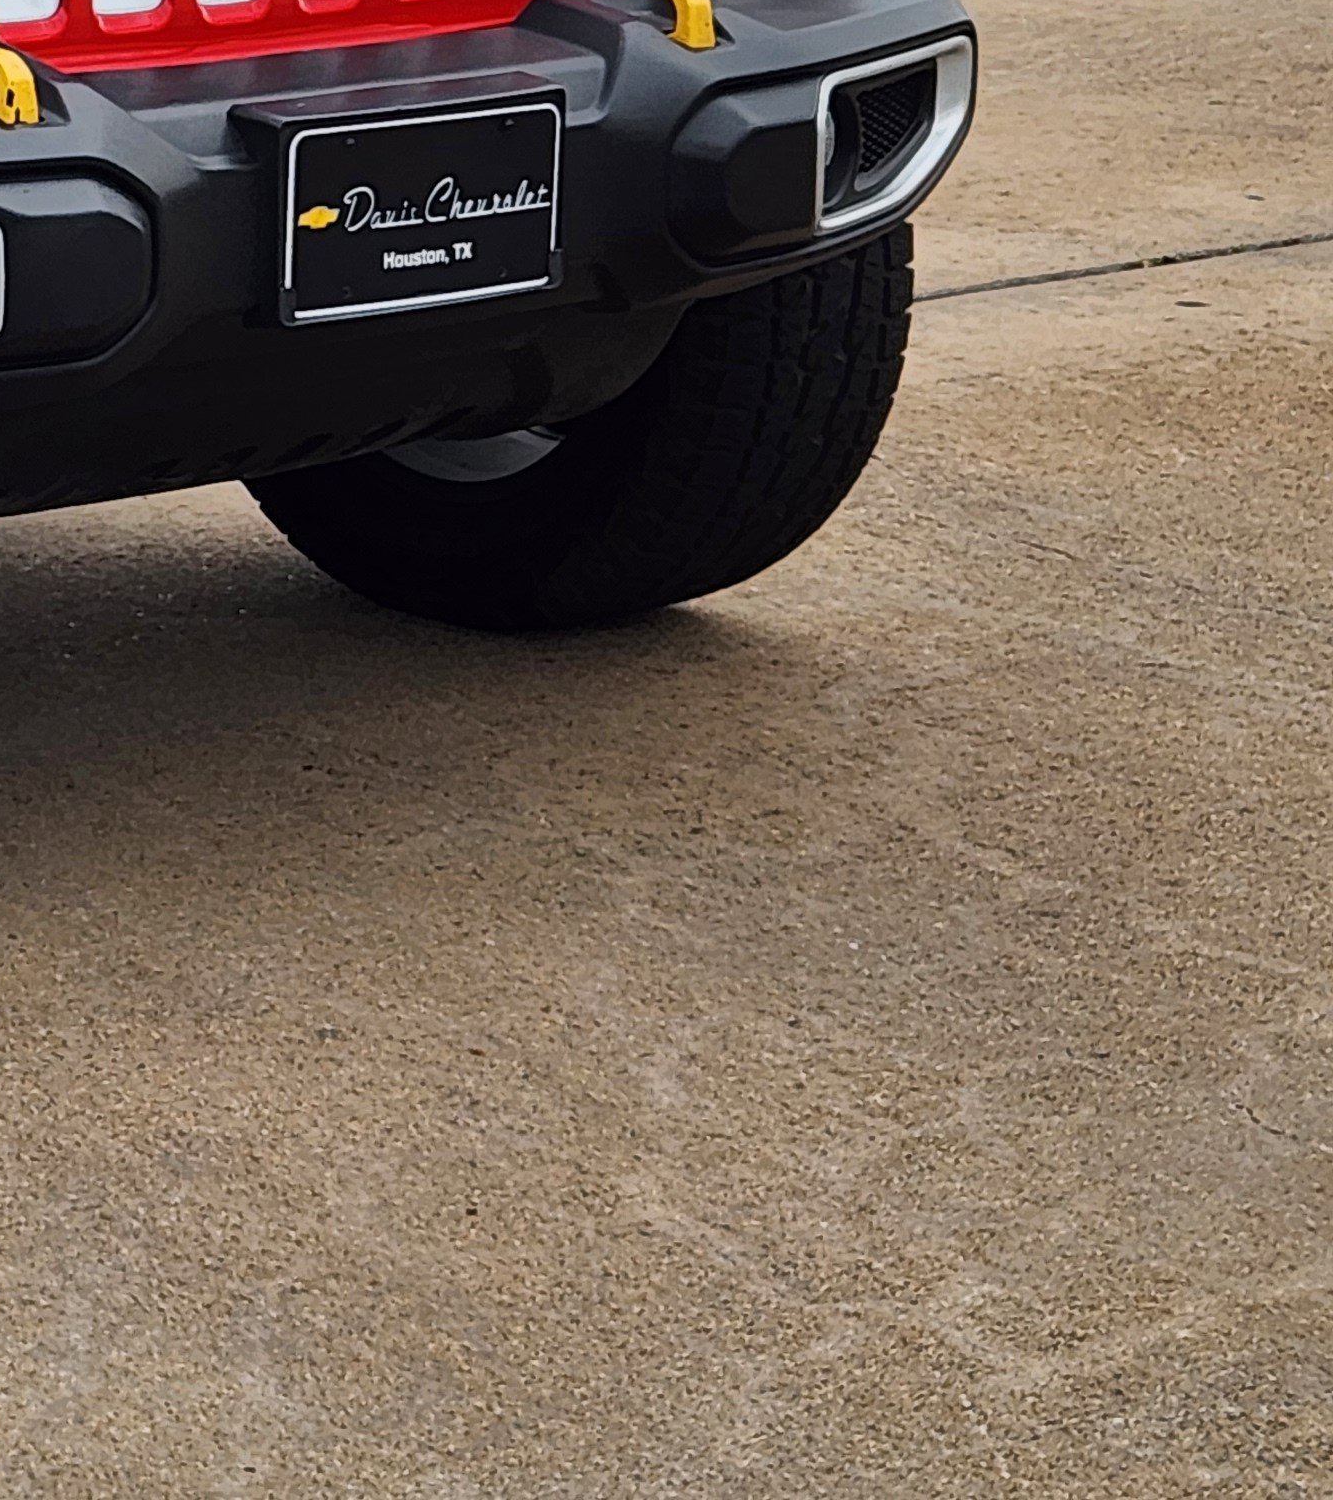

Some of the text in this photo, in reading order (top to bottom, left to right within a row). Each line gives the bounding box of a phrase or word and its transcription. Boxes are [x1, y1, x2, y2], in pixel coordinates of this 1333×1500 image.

[343, 176, 551, 232] Davis Chevrolet
[383, 241, 473, 270] Houston, TX
